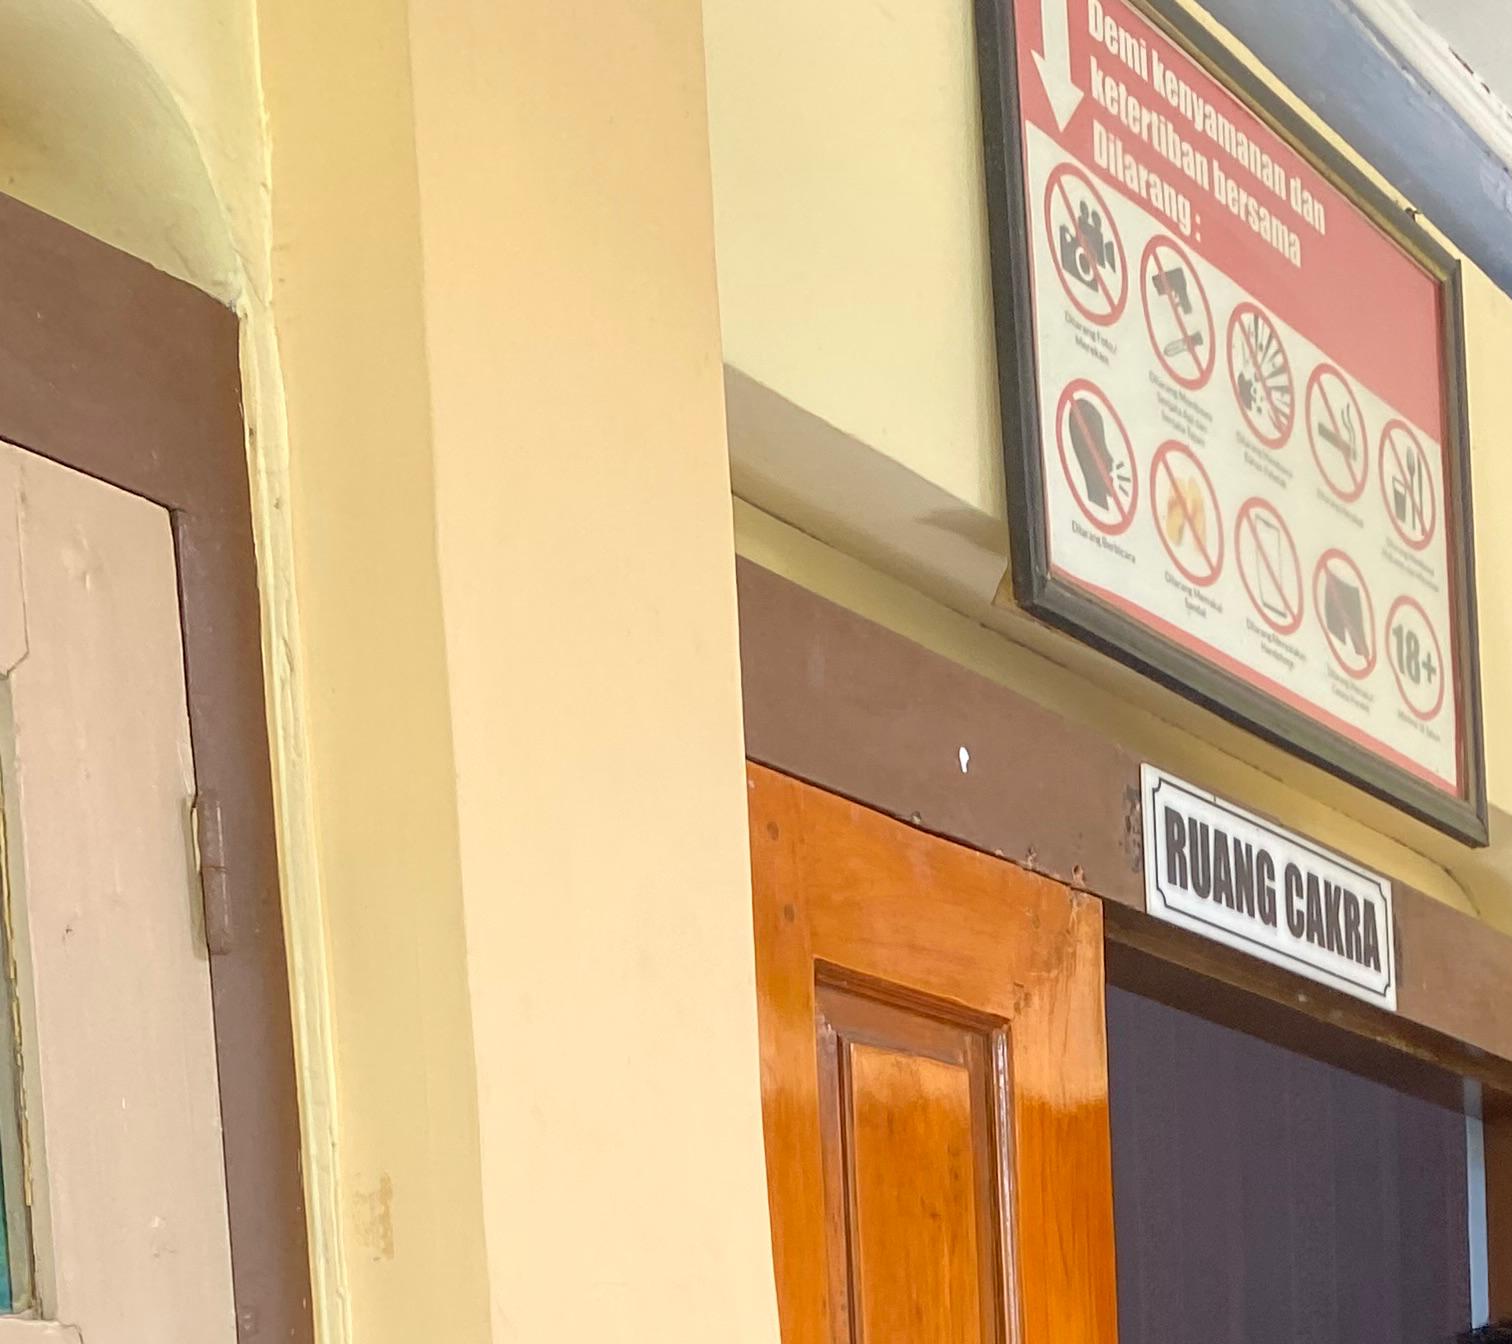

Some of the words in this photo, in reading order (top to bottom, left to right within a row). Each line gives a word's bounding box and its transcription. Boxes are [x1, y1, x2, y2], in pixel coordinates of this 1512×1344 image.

[1088, 0, 1148, 82] Demi
[1152, 48, 1286, 200] kenyamanan
[1289, 176, 1326, 236] dan
[1090, 55, 1210, 191] ketertiban
[1213, 158, 1301, 268] bersama
[1093, 119, 1191, 237] Dilarang
[1392, 623, 1437, 685] 18+
[1164, 805, 1277, 929] RUANG
[1284, 861, 1382, 974] CAKRA
